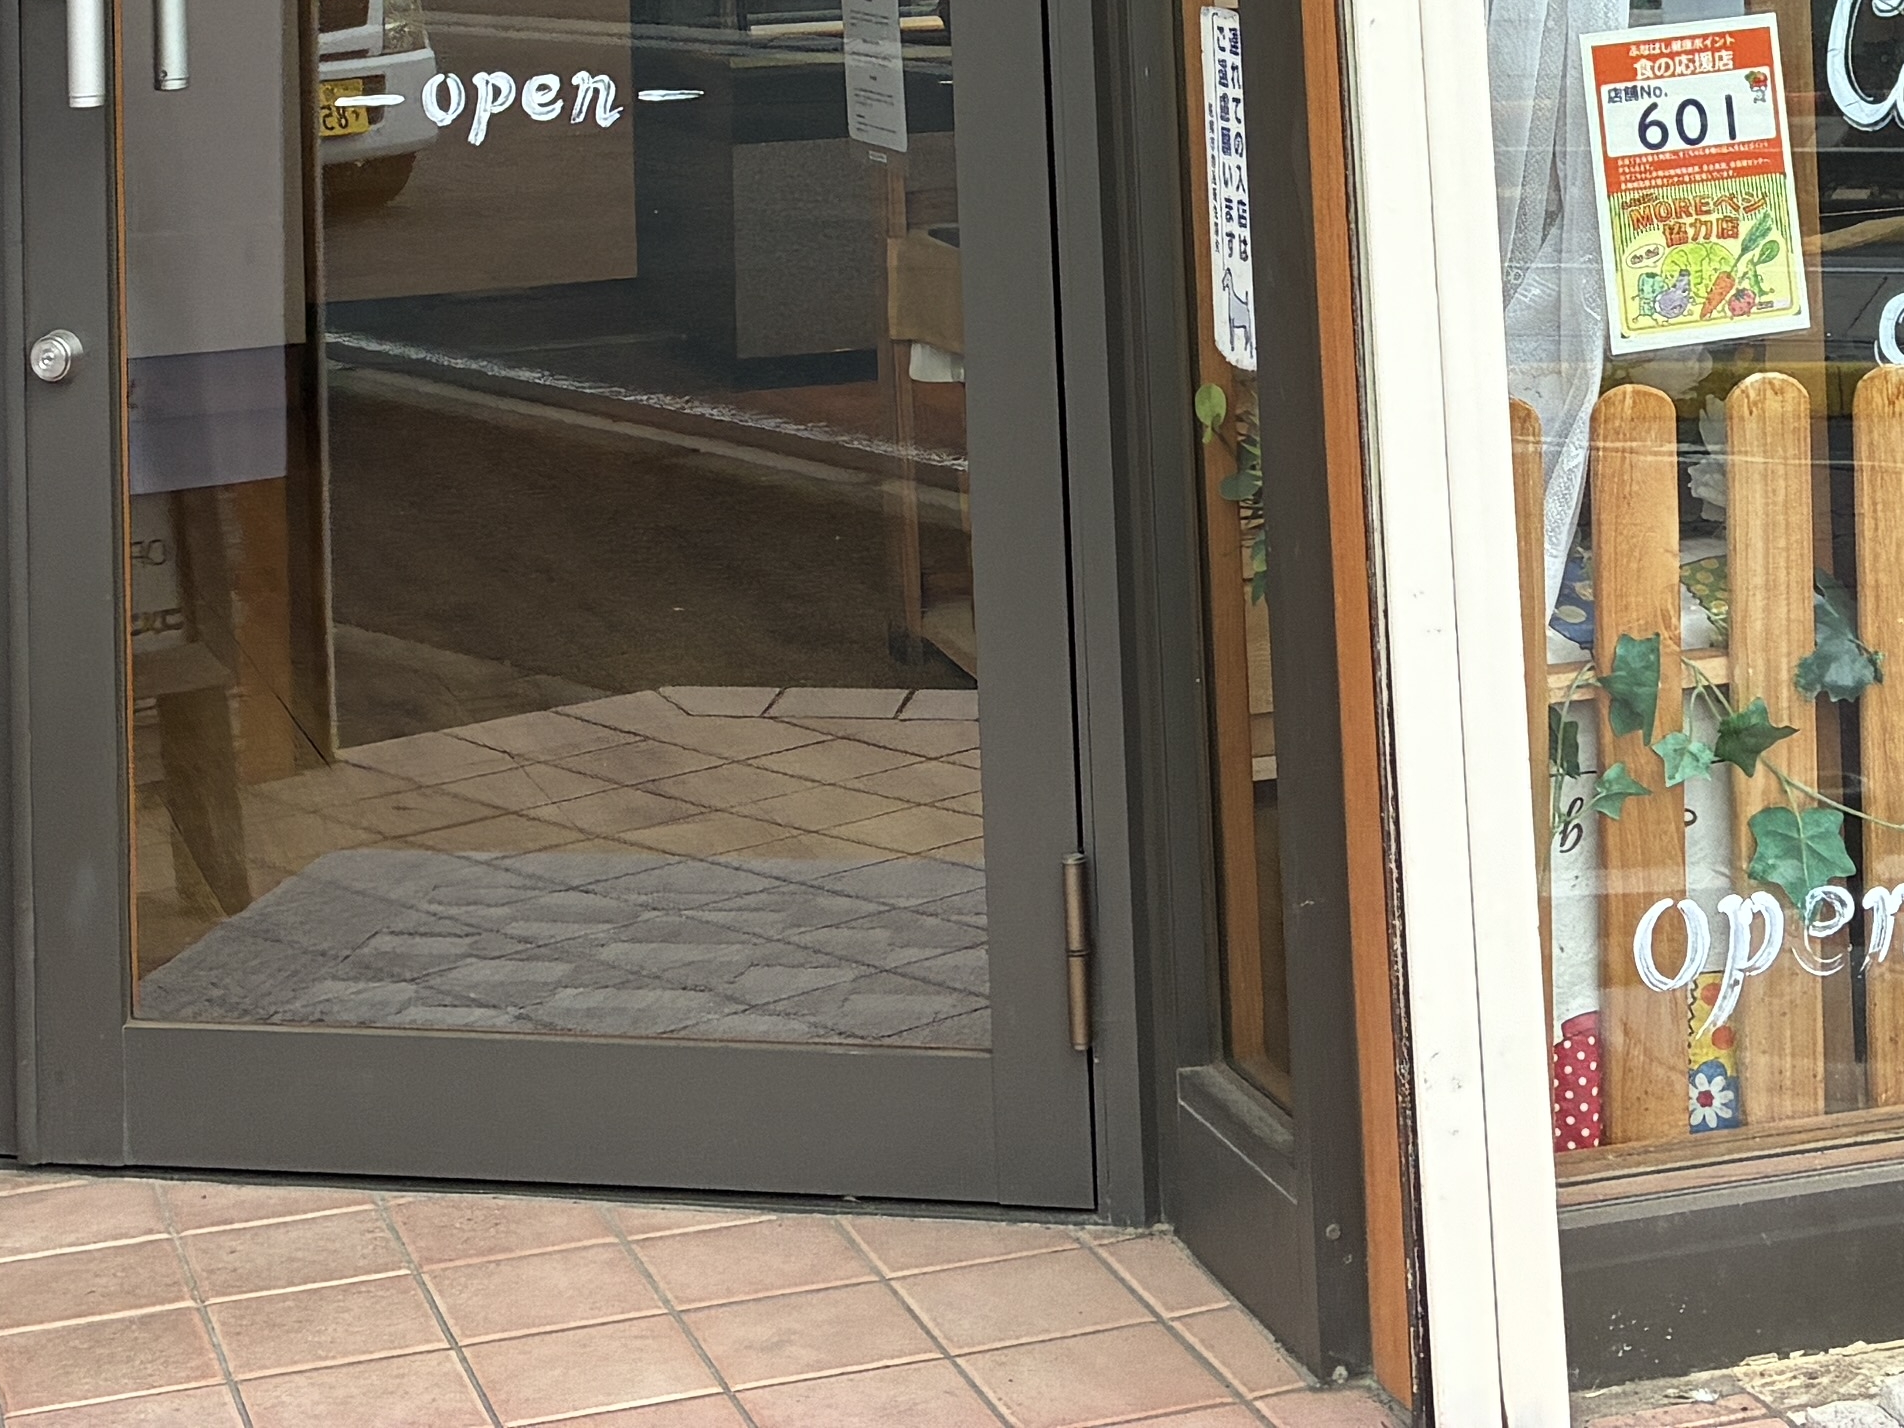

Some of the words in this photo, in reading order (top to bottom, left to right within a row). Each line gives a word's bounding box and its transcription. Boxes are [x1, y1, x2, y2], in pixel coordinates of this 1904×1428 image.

[1633, 49, 1734, 81] 食の応援店
[421, 67, 624, 146] open
[1637, 93, 1738, 151] 601
